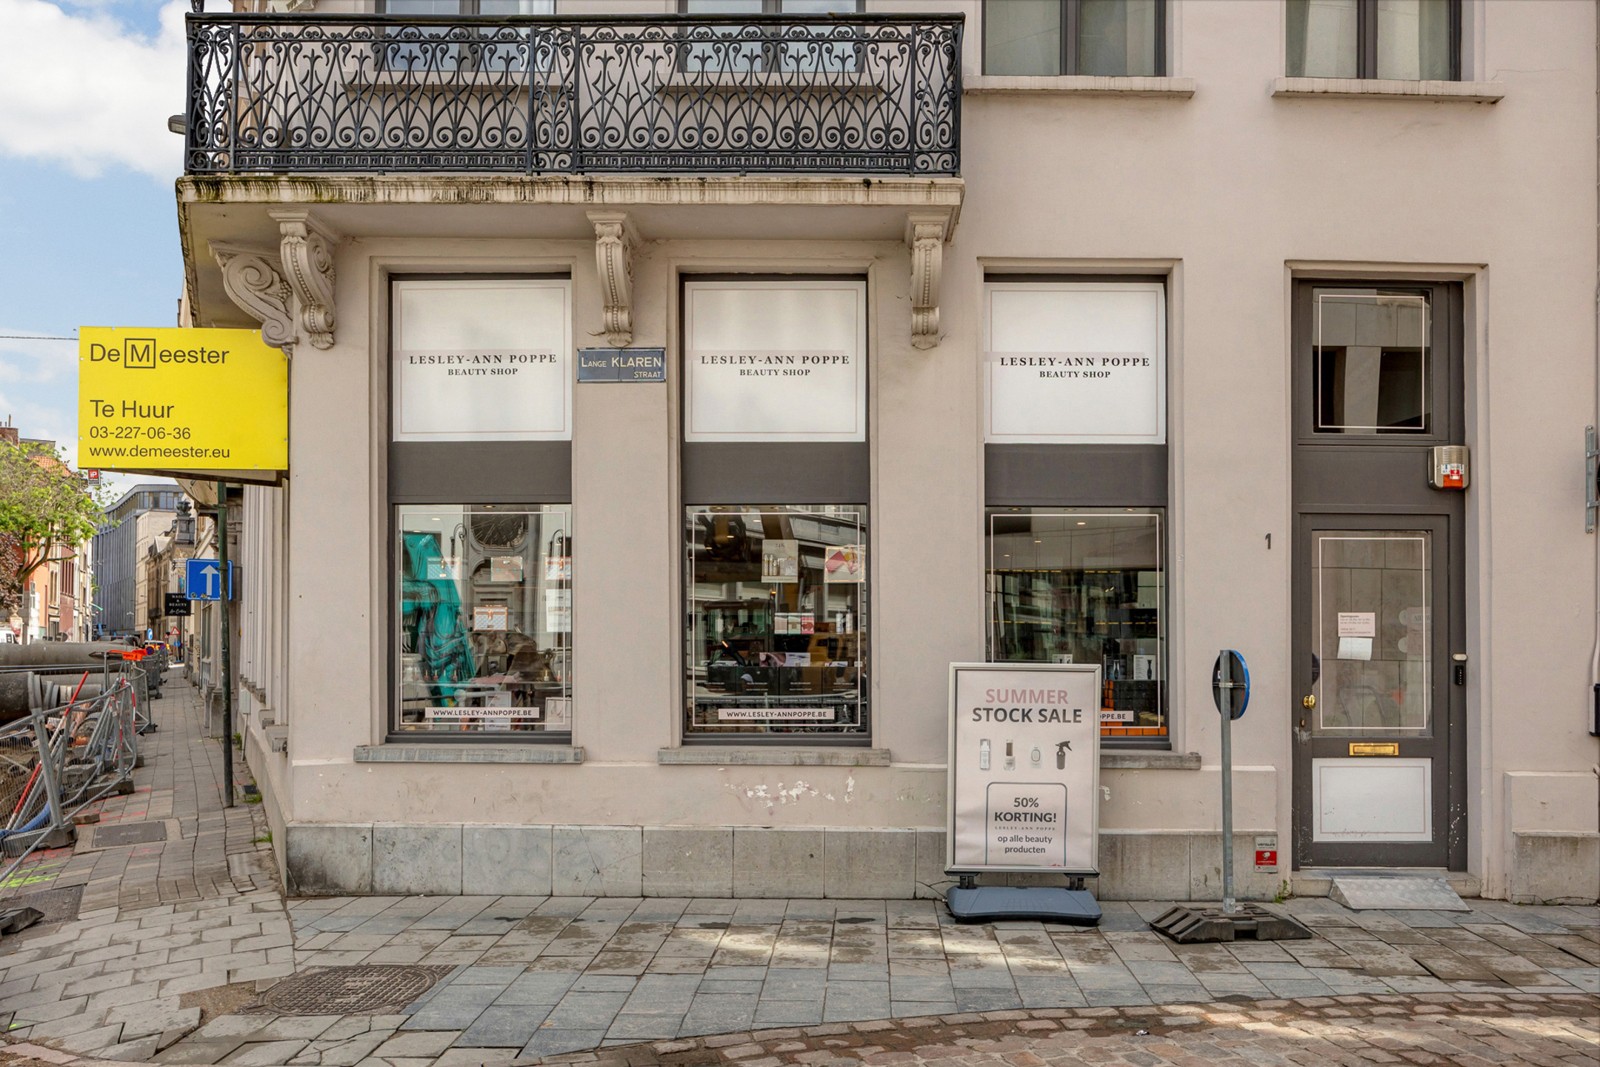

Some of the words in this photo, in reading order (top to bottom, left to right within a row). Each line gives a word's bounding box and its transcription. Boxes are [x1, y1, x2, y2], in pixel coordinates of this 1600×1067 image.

[90, 338, 230, 369] DeMeester
[409, 354, 503, 365] LESLEY-ANN
[509, 354, 557, 364] POPPE
[611, 357, 662, 368] KLAREN
[701, 355, 795, 365] LESLEY-ANN
[802, 355, 850, 365] POPPE
[1000, 357, 1095, 367] LESLEY-ANN
[1102, 357, 1150, 367] POPPE
[448, 368, 488, 376] BEAUTY
[490, 368, 518, 376] SHOP
[633, 371, 662, 379] STRAAT
[739, 368, 780, 376] BEAUTY
[783, 368, 811, 376] SHOP
[1039, 370, 1080, 378] BEAUTY
[1083, 370, 1111, 378] SHOP
[90, 399, 115, 418] Te
[122, 399, 175, 419] Huur
[89, 426, 191, 440] 03-227-06-36
[89, 445, 231, 459] www.demeester.eu
[1264, 532, 1272, 550] 1
[985, 688, 1069, 705] SUMMER
[432, 709, 532, 717] WWW.LESLEY-ANNPOPPE.BE
[972, 707, 1033, 723] STOCK
[1038, 708, 1083, 724] SALE
[1013, 797, 1040, 808] 50%
[994, 811, 1057, 823] KORTING!
[997, 836, 1008, 844] op
[1009, 835, 1024, 843] alle
[1025, 834, 1053, 845] beauty
[1004, 846, 1046, 855] producten
